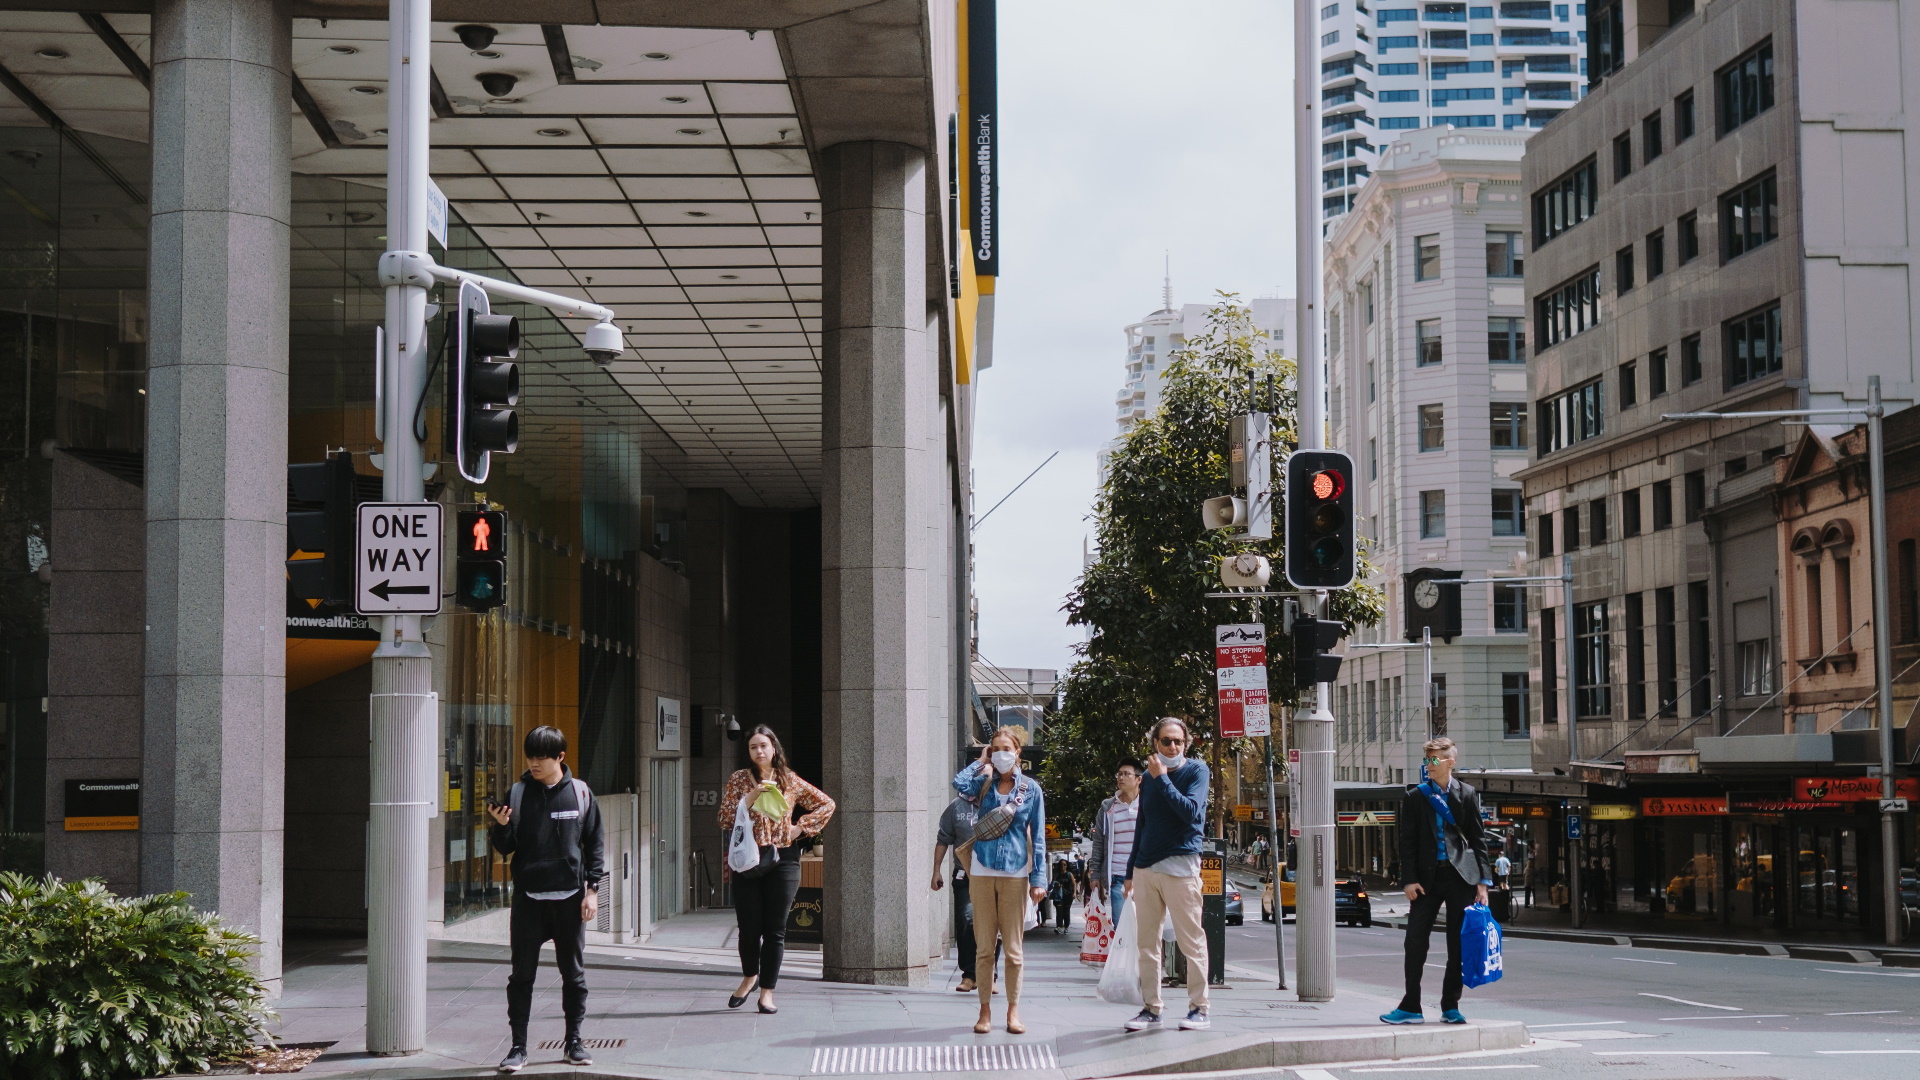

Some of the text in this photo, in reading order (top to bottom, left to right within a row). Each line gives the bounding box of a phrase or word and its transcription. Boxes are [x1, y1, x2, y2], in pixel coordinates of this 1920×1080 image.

[977, 113, 992, 261] CommonwealthBank
[372, 514, 428, 538] ONE
[367, 548, 431, 572] WAY
[1221, 669, 1234, 678] 4P
[1810, 788, 1824, 797] MC
[1830, 780, 1872, 794] MEDAN
[692, 790, 718, 806] 133
[1667, 803, 1717, 813] YASAKA
[1571, 817, 1578, 826] P
